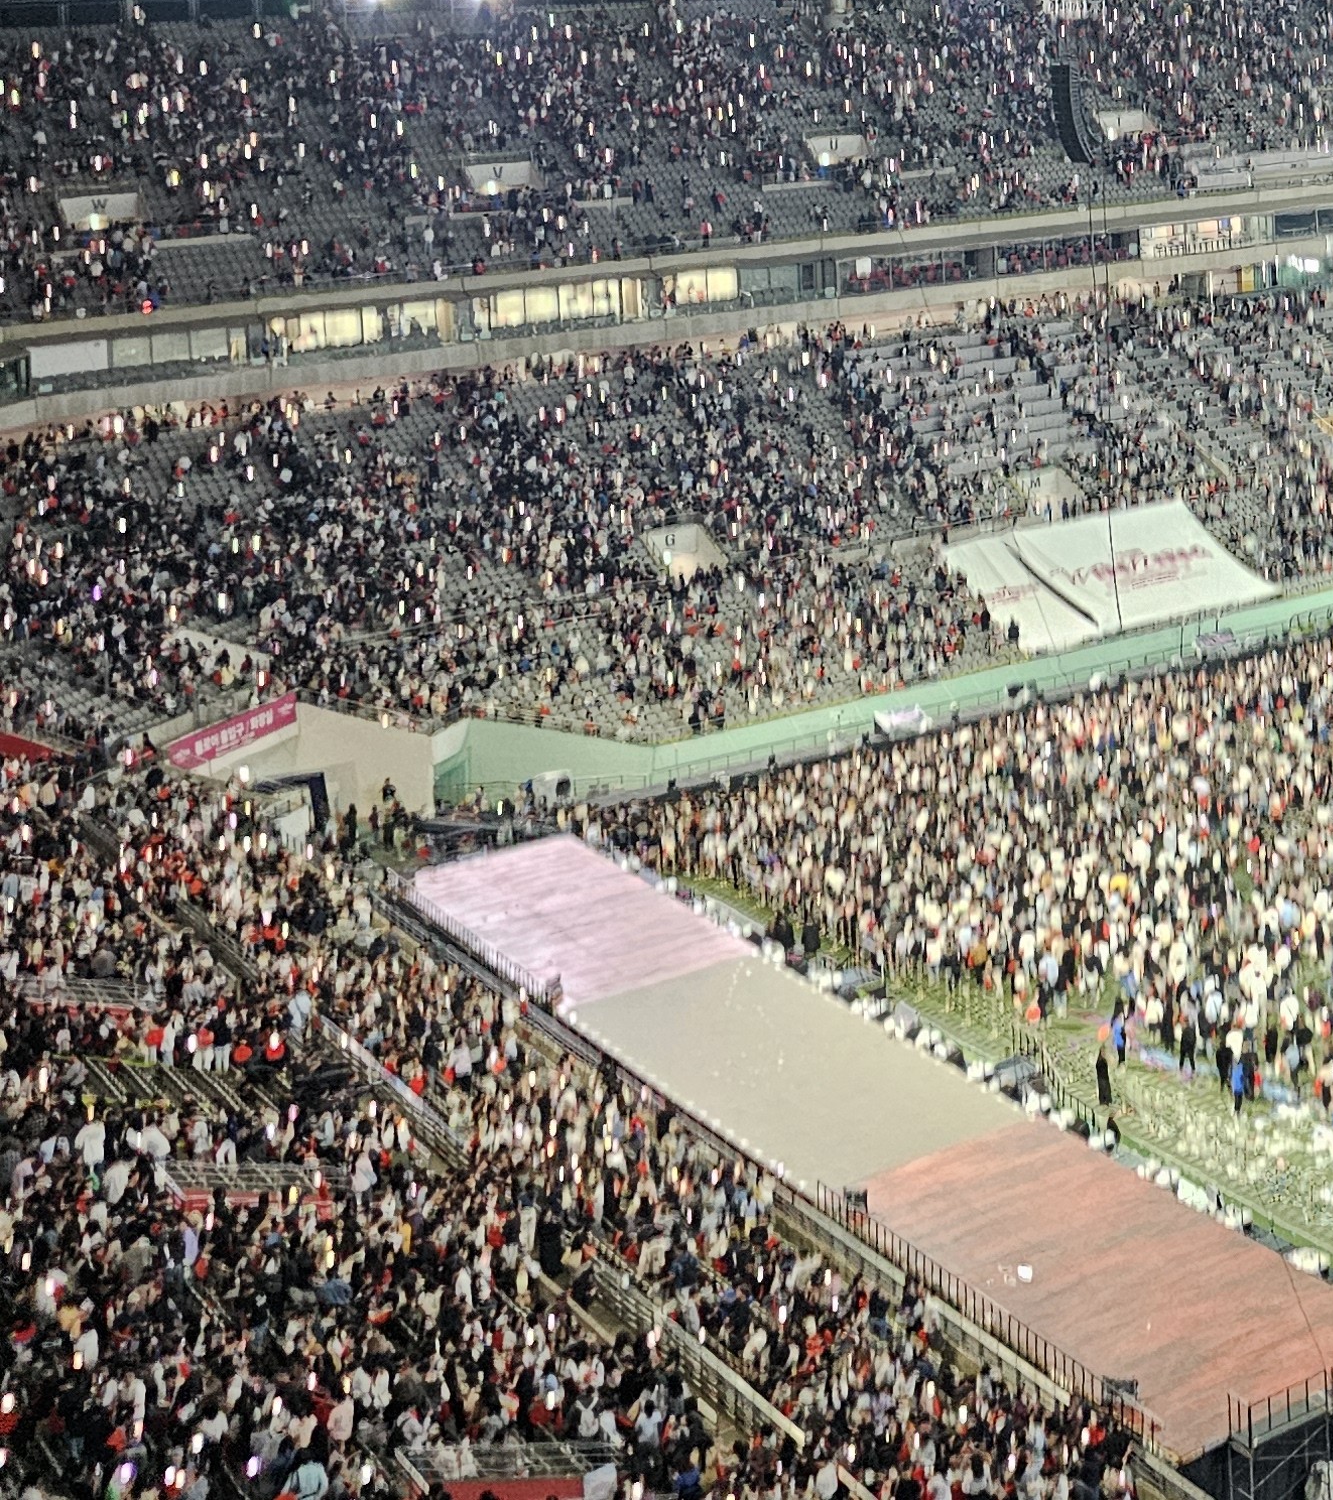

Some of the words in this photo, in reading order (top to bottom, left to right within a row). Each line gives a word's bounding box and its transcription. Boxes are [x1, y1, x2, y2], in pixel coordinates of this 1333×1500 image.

[830, 137, 838, 151] U
[492, 165, 503, 179] V
[91, 198, 107, 210] W
[665, 533, 676, 547] G
